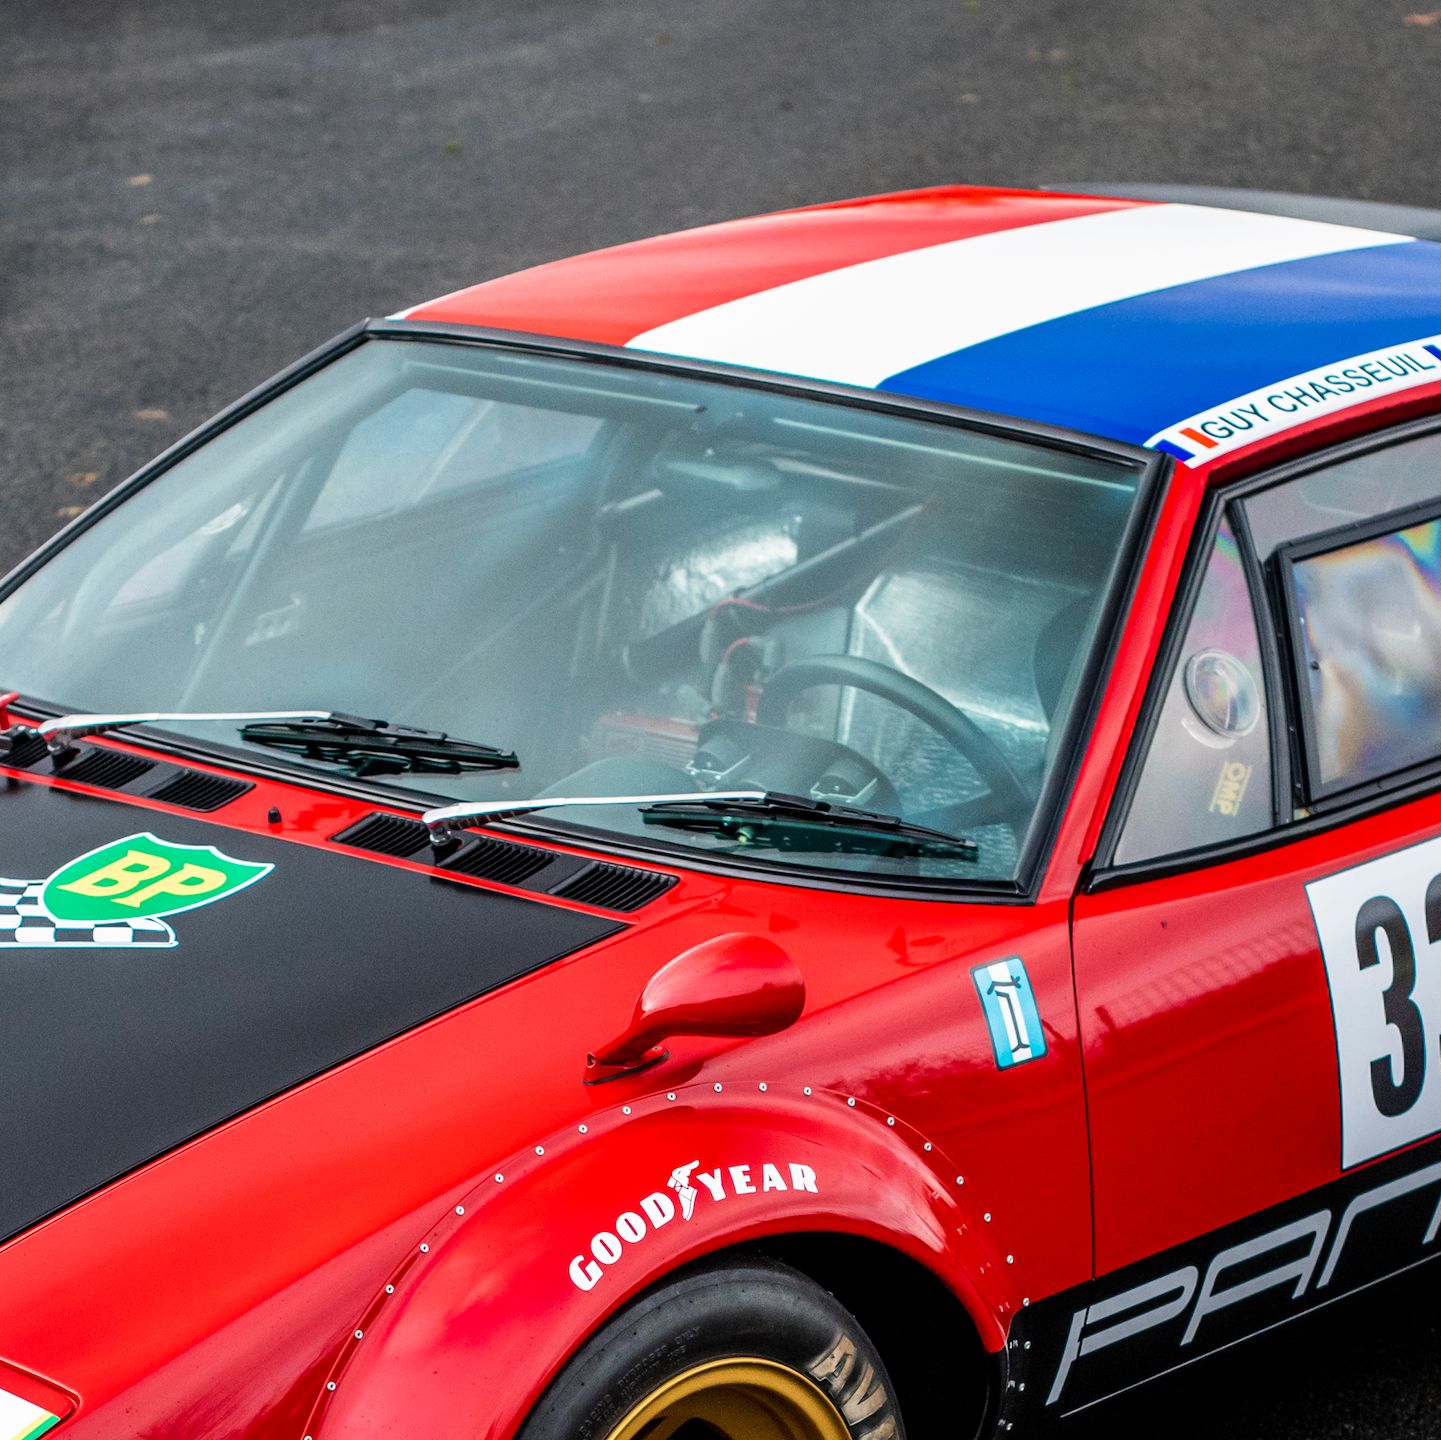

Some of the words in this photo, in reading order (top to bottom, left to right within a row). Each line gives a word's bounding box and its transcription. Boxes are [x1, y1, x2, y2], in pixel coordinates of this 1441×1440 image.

[1200, 403, 1270, 439] GUY
[1267, 352, 1436, 413] CHASSEUIL
[57, 851, 227, 908] BP
